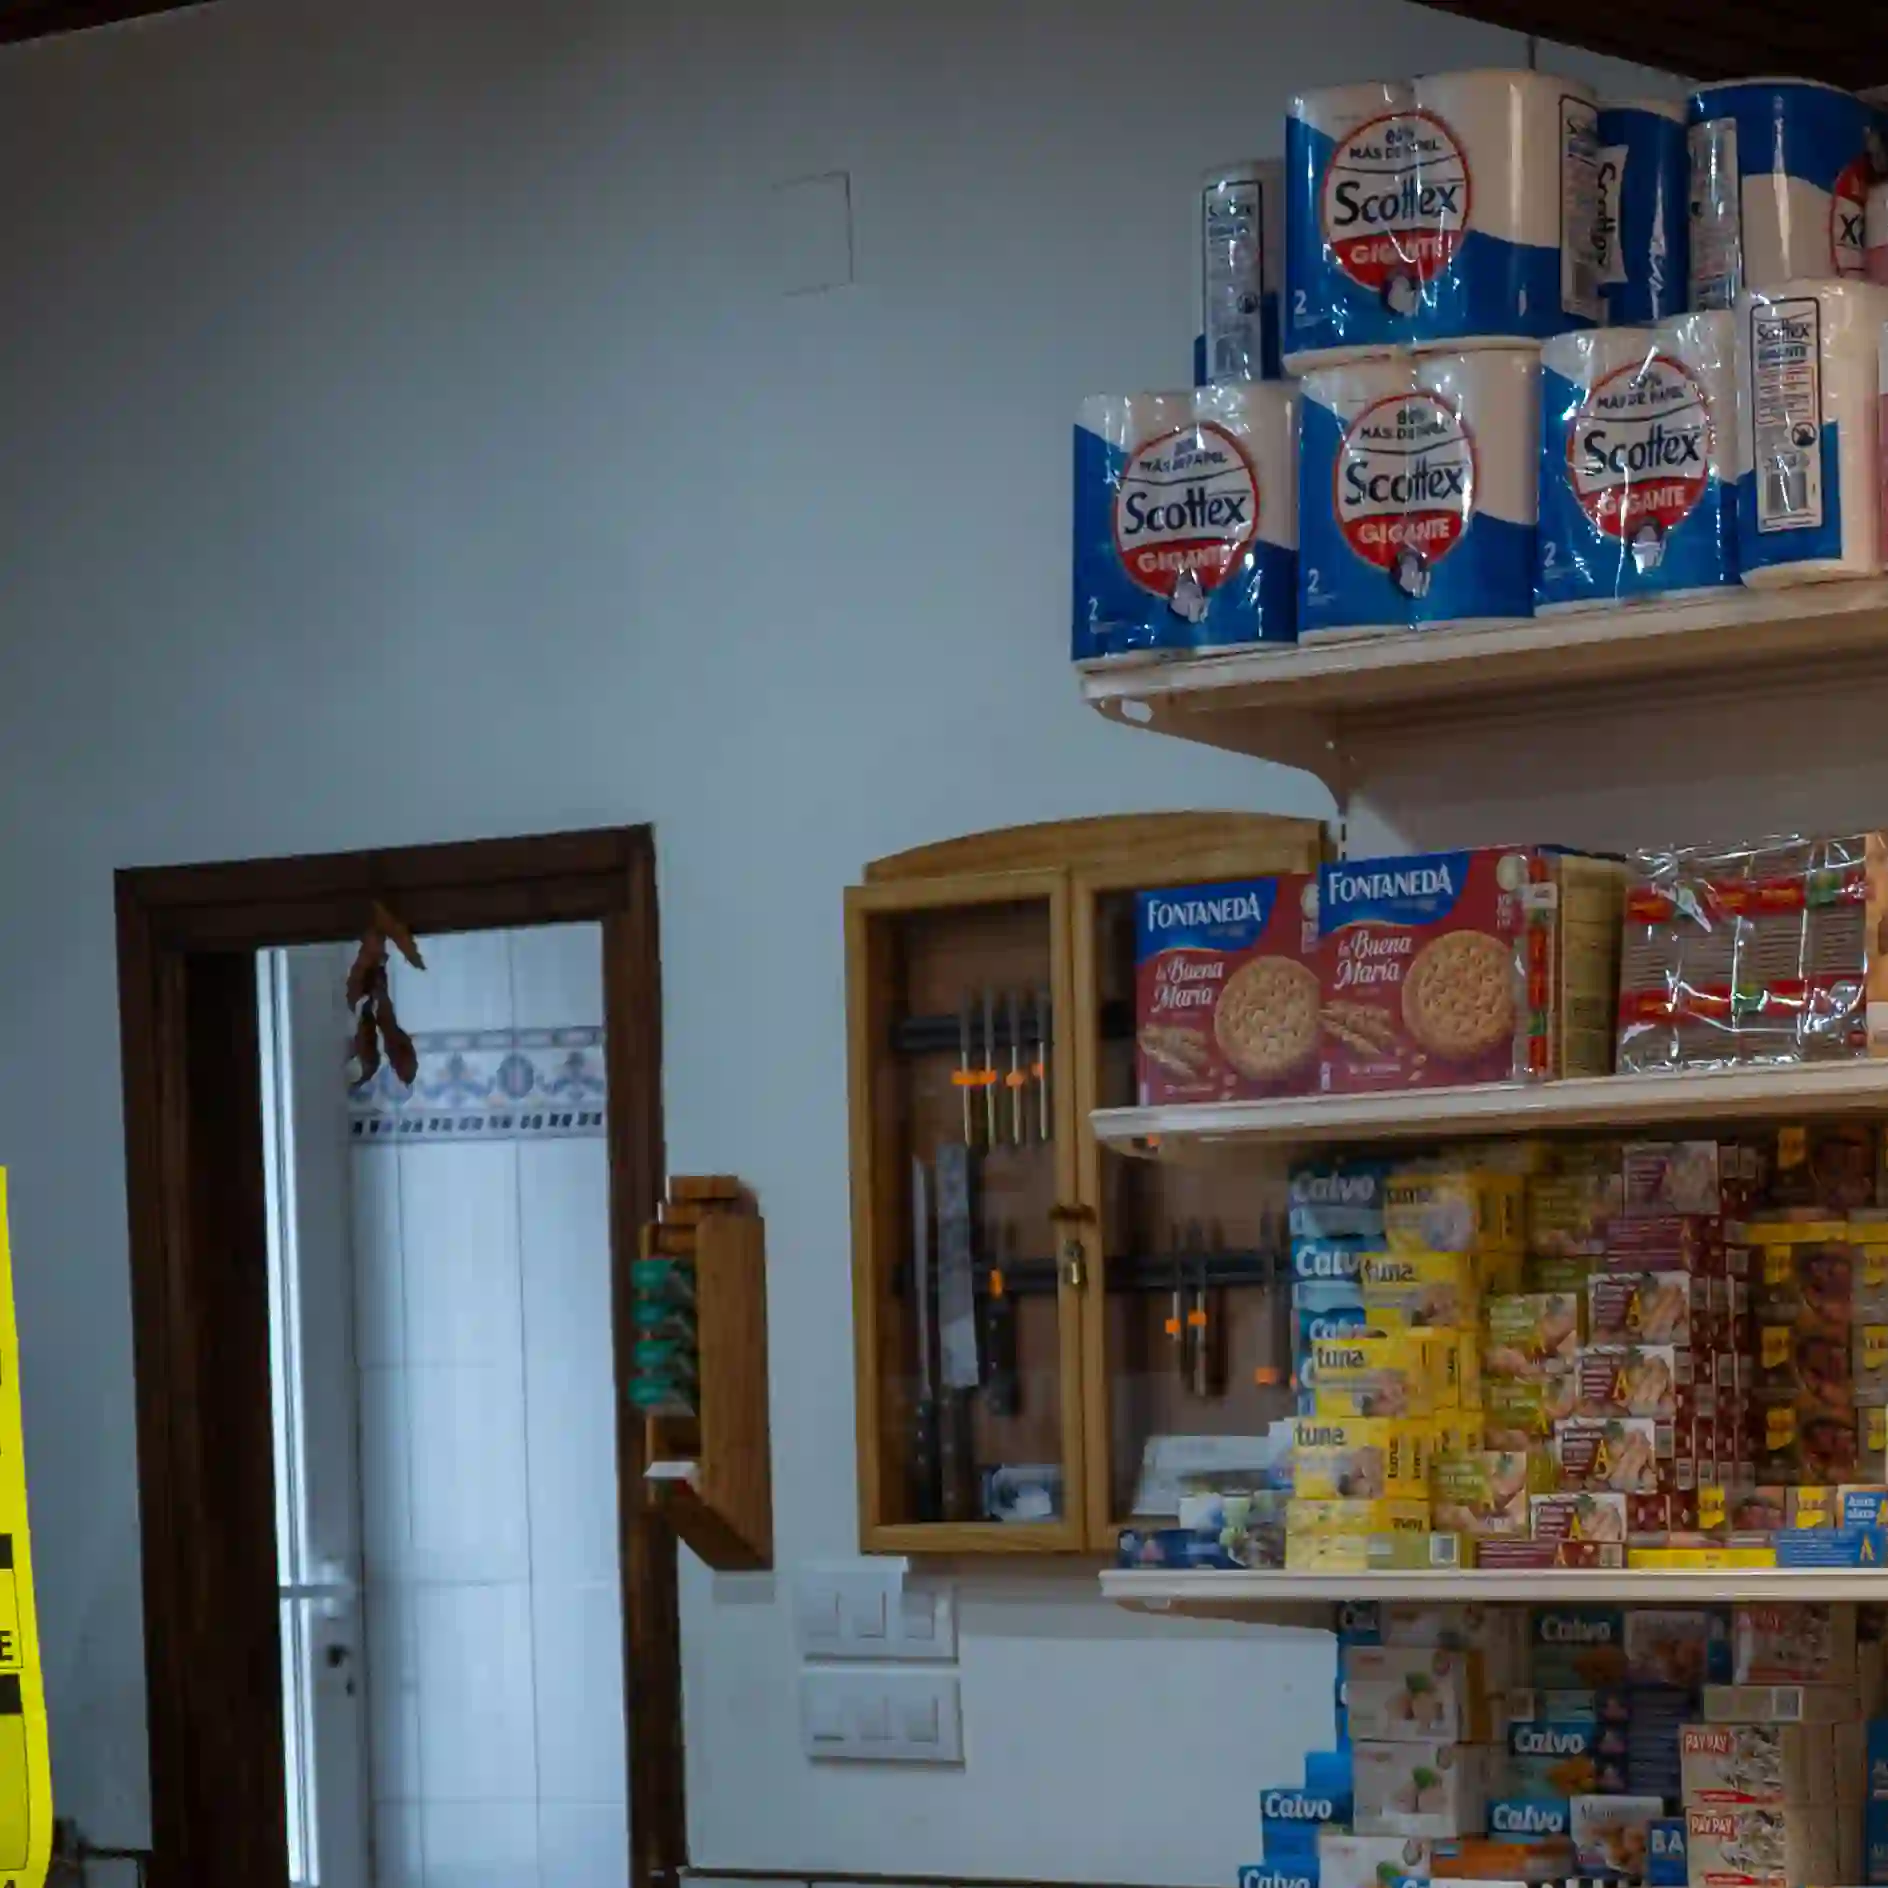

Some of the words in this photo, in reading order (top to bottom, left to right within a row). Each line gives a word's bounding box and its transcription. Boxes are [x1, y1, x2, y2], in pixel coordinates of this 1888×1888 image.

[1342, 458, 1464, 505] Scottex
[1123, 490, 1249, 536] Scottex
[1600, 485, 1686, 516] GIGANTE
[1358, 517, 1451, 546] GIGANTE
[1308, 569, 1318, 593] 2
[1327, 863, 1453, 906] FONTANEDA
[1146, 892, 1262, 934] FONTANEDA
[1353, 929, 1412, 957] Buena
[1170, 957, 1224, 983] Buena
[1334, 954, 1400, 989] María
[1154, 983, 1214, 1013] María
[1317, 1345, 1367, 1370] tuna
[1295, 1423, 1345, 1447] tuna
[1492, 1803, 1564, 1832] Calvo
